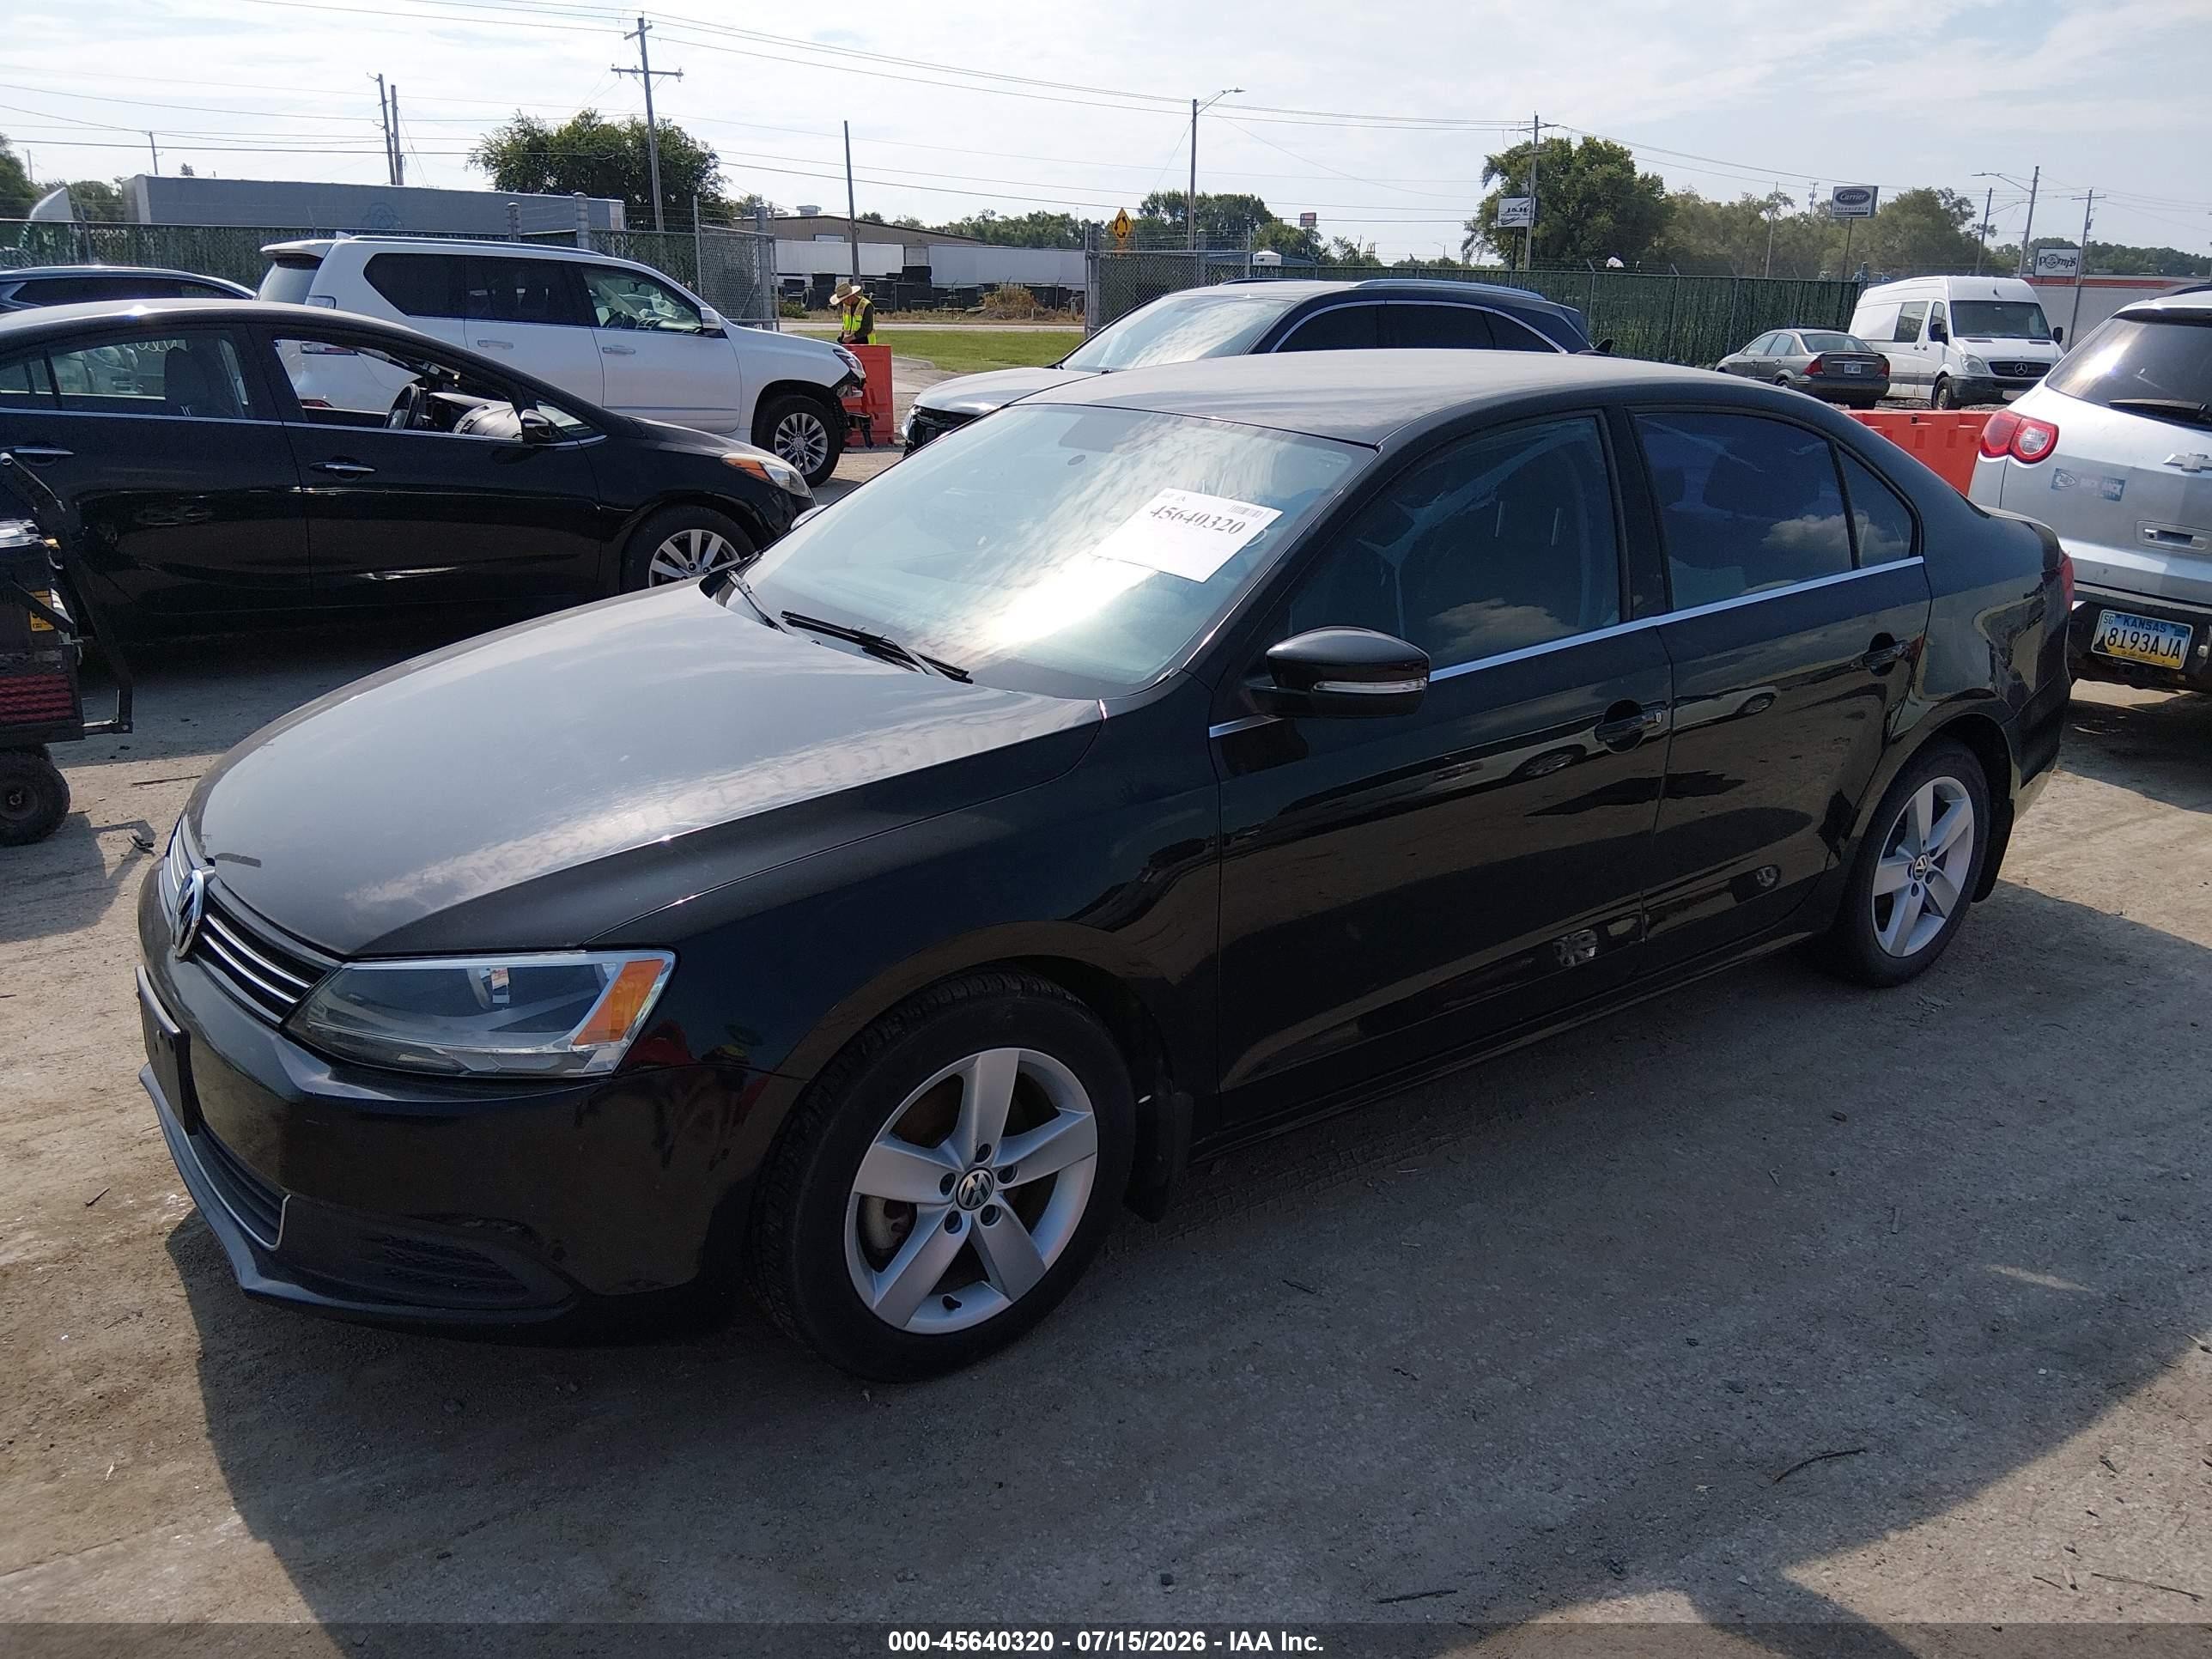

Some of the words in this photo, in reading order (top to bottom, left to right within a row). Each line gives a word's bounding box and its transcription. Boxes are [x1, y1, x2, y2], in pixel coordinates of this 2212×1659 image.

[1150, 505, 1246, 535] 45640320
[2103, 615, 2113, 625] SG
[2123, 617, 2167, 634] KANSAS
[2107, 627, 2182, 659] 8193AJA
